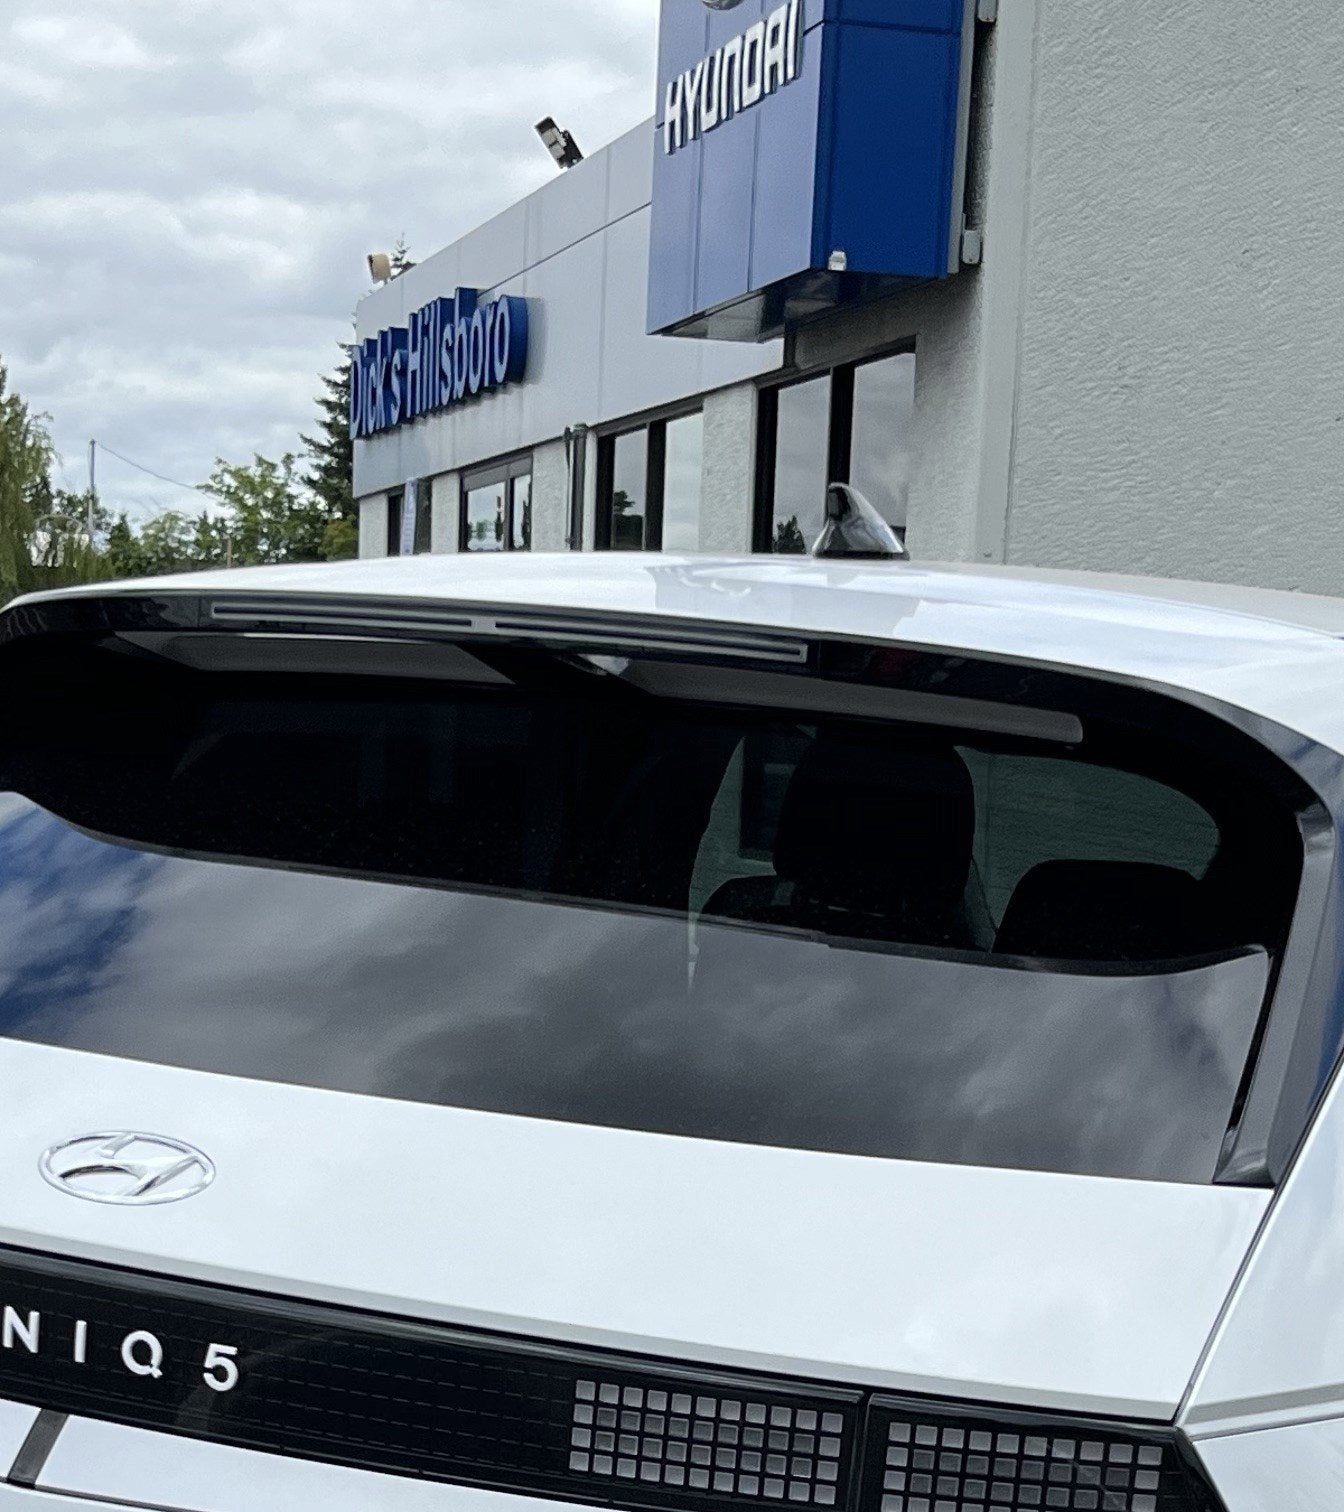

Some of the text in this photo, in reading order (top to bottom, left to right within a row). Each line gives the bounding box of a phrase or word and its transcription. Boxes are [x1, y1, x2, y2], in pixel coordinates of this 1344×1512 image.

[664, 0, 799, 155] HYUNDAI
[350, 287, 512, 440] Dick's Hillsboro
[203, 1342, 239, 1392] 5
